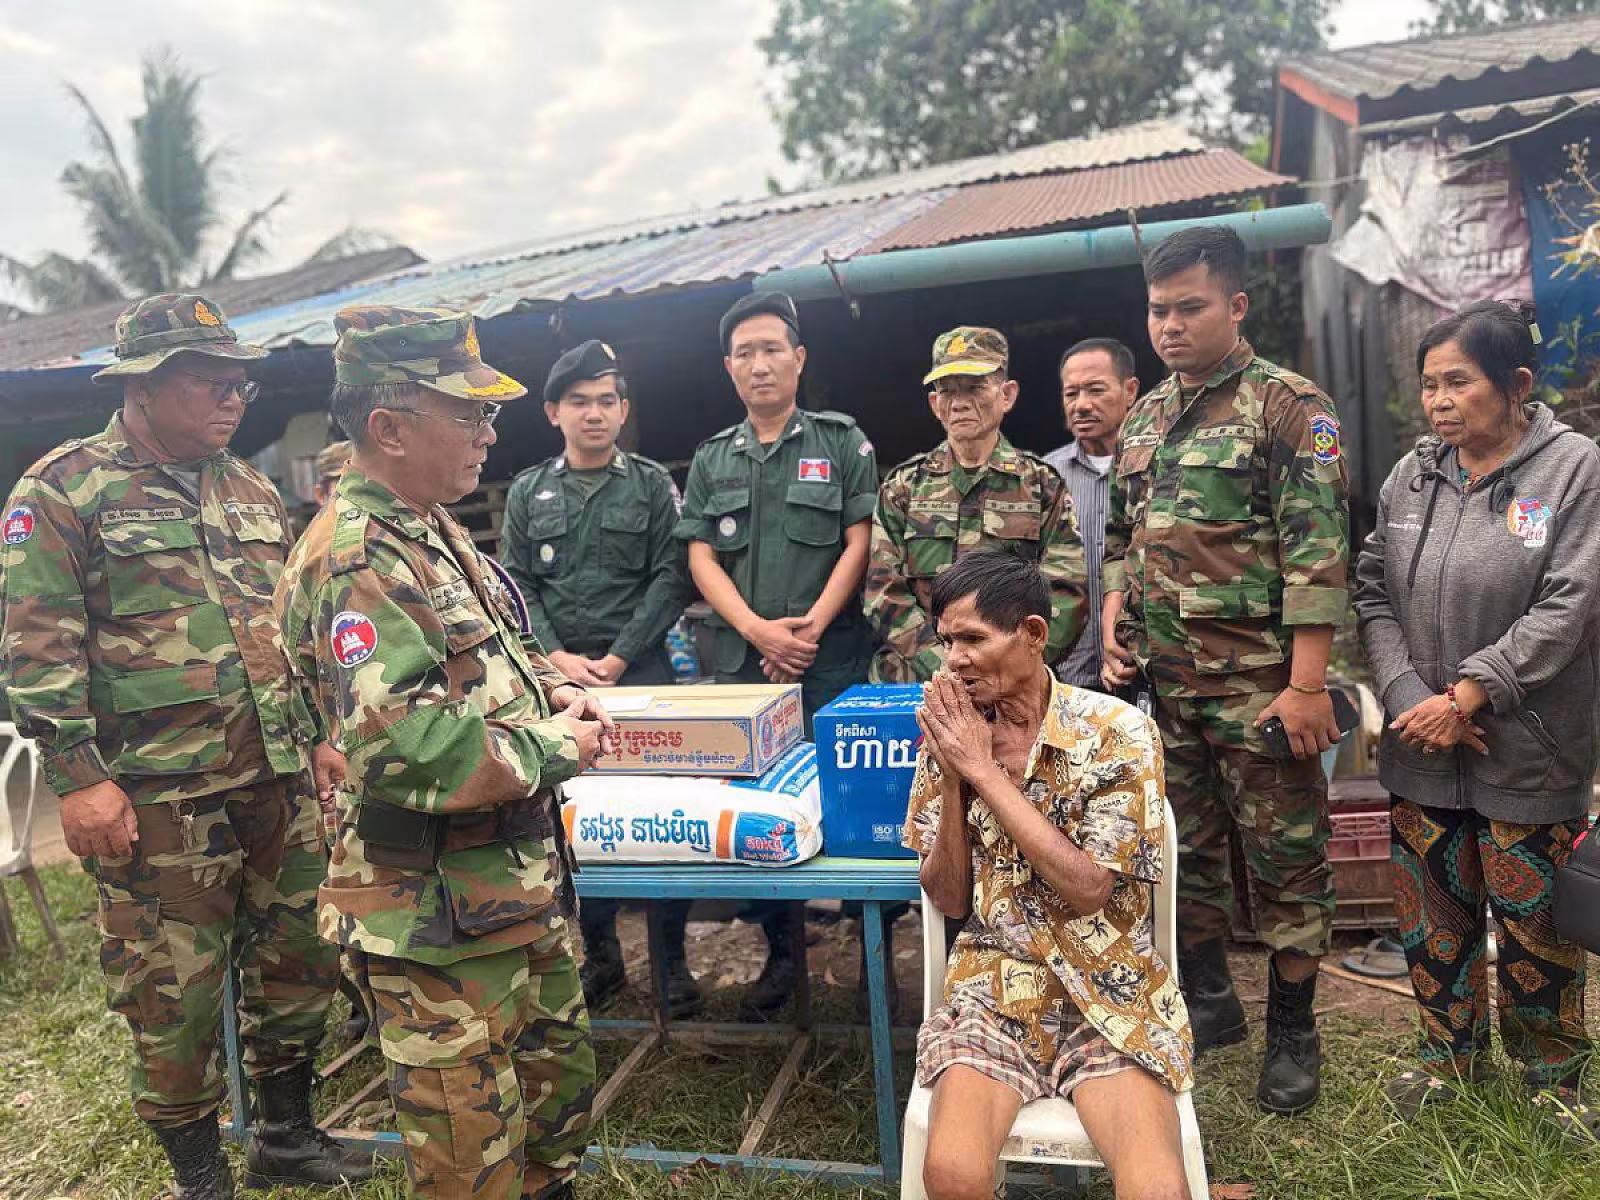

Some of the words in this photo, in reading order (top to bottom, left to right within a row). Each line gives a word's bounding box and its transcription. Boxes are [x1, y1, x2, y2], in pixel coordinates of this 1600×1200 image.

[579, 812, 625, 853] អង្ករ
[631, 808, 711, 852] នាងមិញ
[875, 826, 892, 834] ISO
